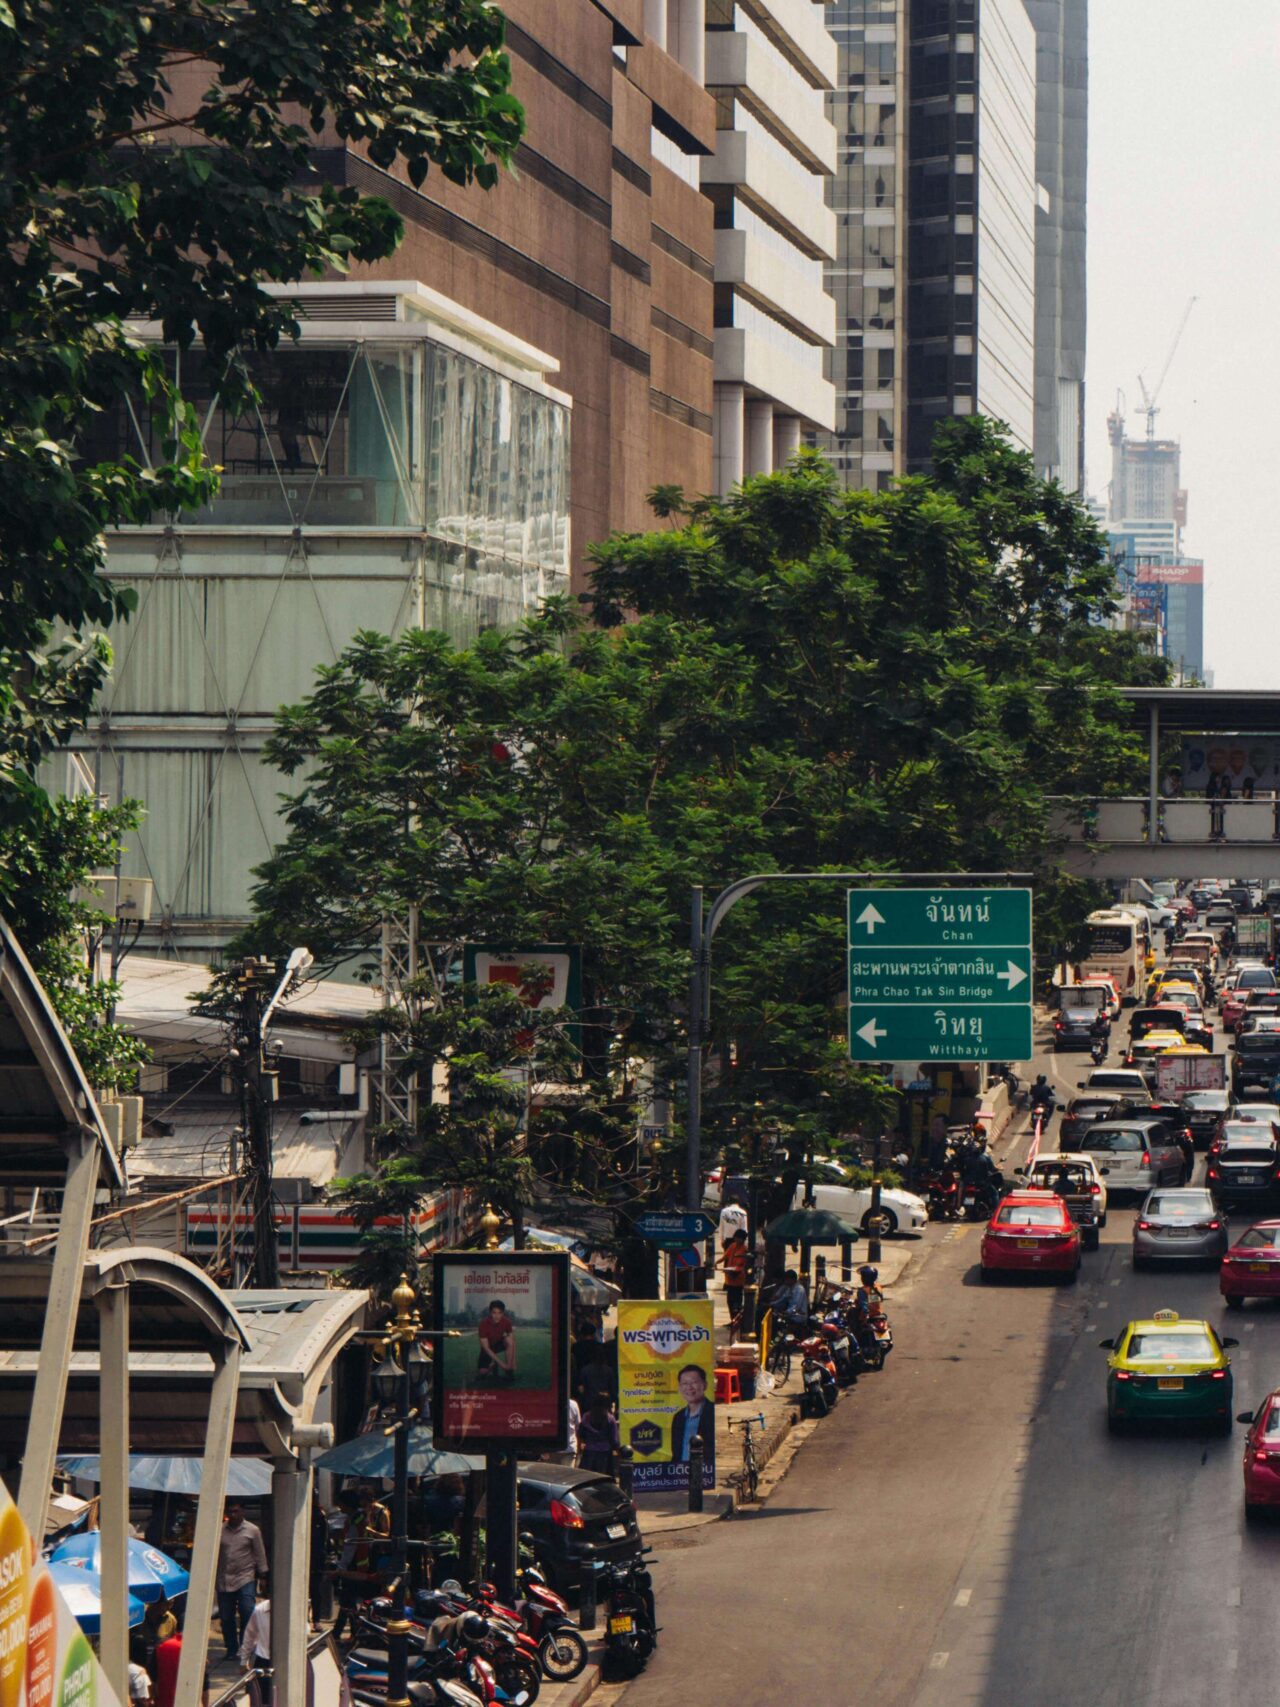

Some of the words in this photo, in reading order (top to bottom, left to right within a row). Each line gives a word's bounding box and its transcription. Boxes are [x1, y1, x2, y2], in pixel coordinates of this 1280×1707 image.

[926, 896, 992, 922] จันทน์
[942, 930, 974, 940] Chan
[853, 957, 995, 976] สะพานพระเจ้าตากสิน
[854, 986, 878, 996] Phra
[883, 986, 910, 996] Chao
[915, 986, 933, 996] Tak
[938, 986, 955, 996] Sin
[959, 986, 993, 998] Bridge
[934, 1010, 983, 1043] วิทยุ
[929, 1045, 988, 1055] Witthayu
[694, 1219, 703, 1232] 3
[464, 1270, 491, 1285] เอไอเอ
[623, 1325, 710, 1348] พระพุทธเจ้า
